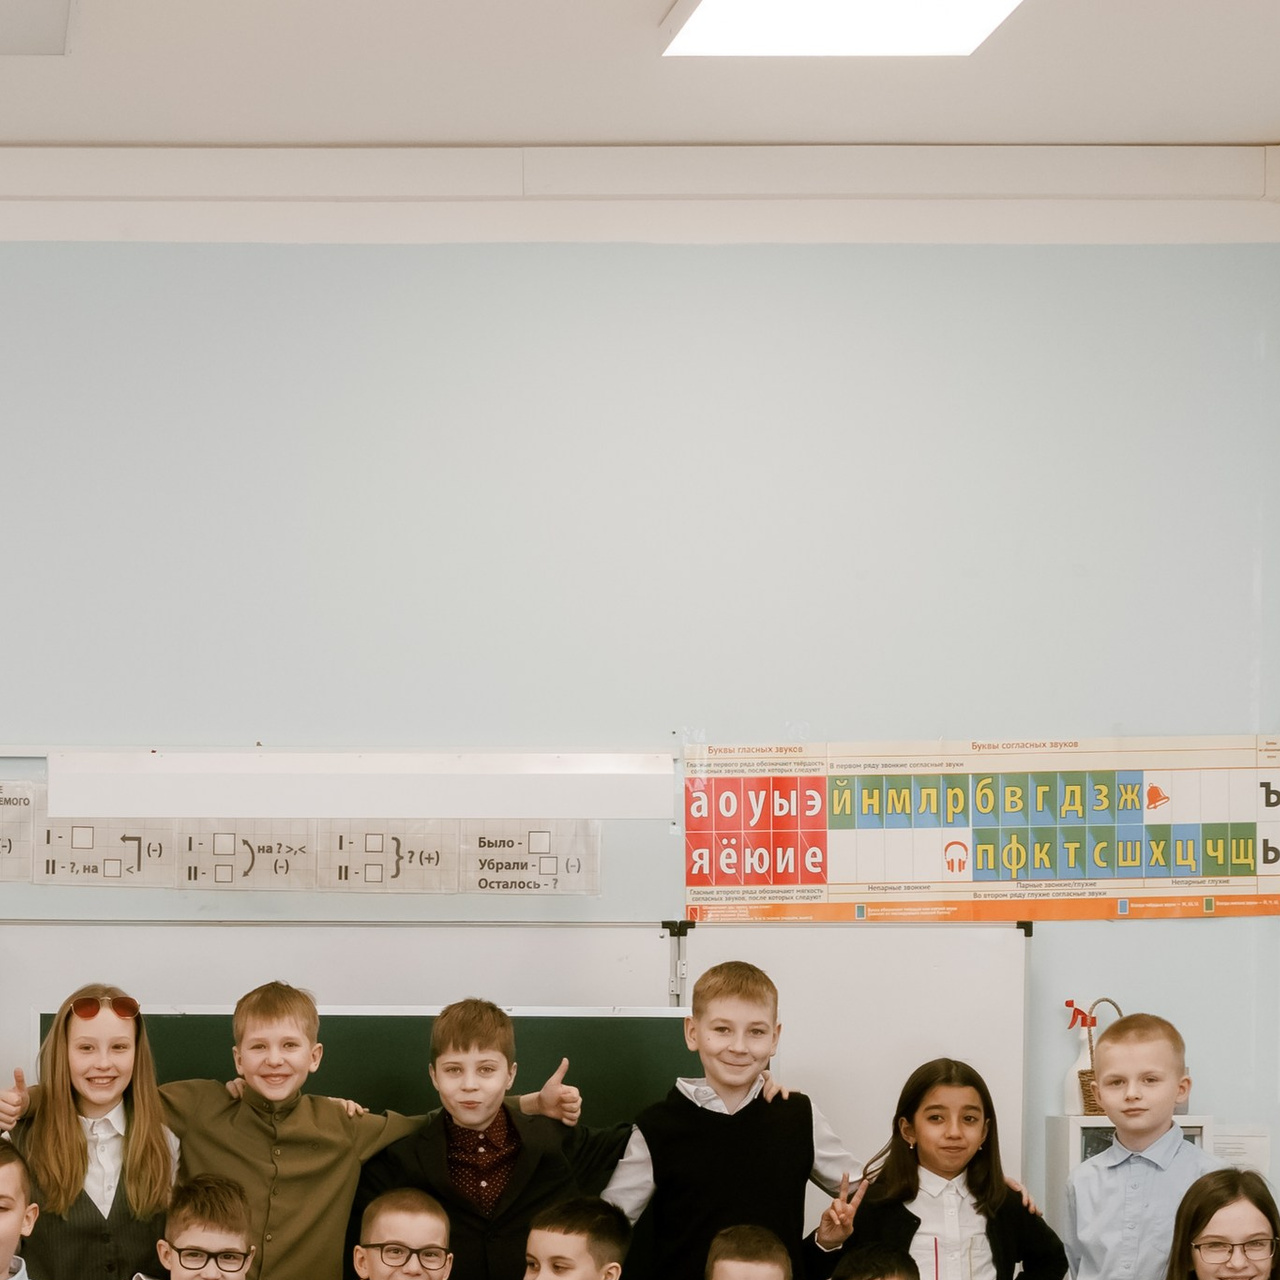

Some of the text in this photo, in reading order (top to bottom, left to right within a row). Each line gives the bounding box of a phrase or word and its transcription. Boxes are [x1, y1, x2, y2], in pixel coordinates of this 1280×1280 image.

[707, 745, 735, 755] Буквы
[775, 746, 803, 755] звуков
[971, 741, 1079, 751] Буквы согласных звуков
[863, 762, 880, 770] ряду
[945, 762, 964, 770] звуки
[478, 836, 514, 848] Было
[257, 845, 273, 854] на
[83, 864, 98, 874] на
[478, 858, 528, 872] Убрали
[478, 878, 541, 889] Осталось
[1016, 880, 1097, 889] Парные звонкие/глухие
[1171, 878, 1230, 886] Непарные глухие
[758, 887, 795, 895] обозначают
[796, 887, 823, 895] мягкость
[867, 883, 931, 892] Непарные звонкие
[795, 893, 821, 901] следуют
[1009, 892, 1026, 900] ряду
[1027, 891, 1050, 899] глухие
[1051, 890, 1086, 898] согласные
[1088, 889, 1107, 898] звуки
